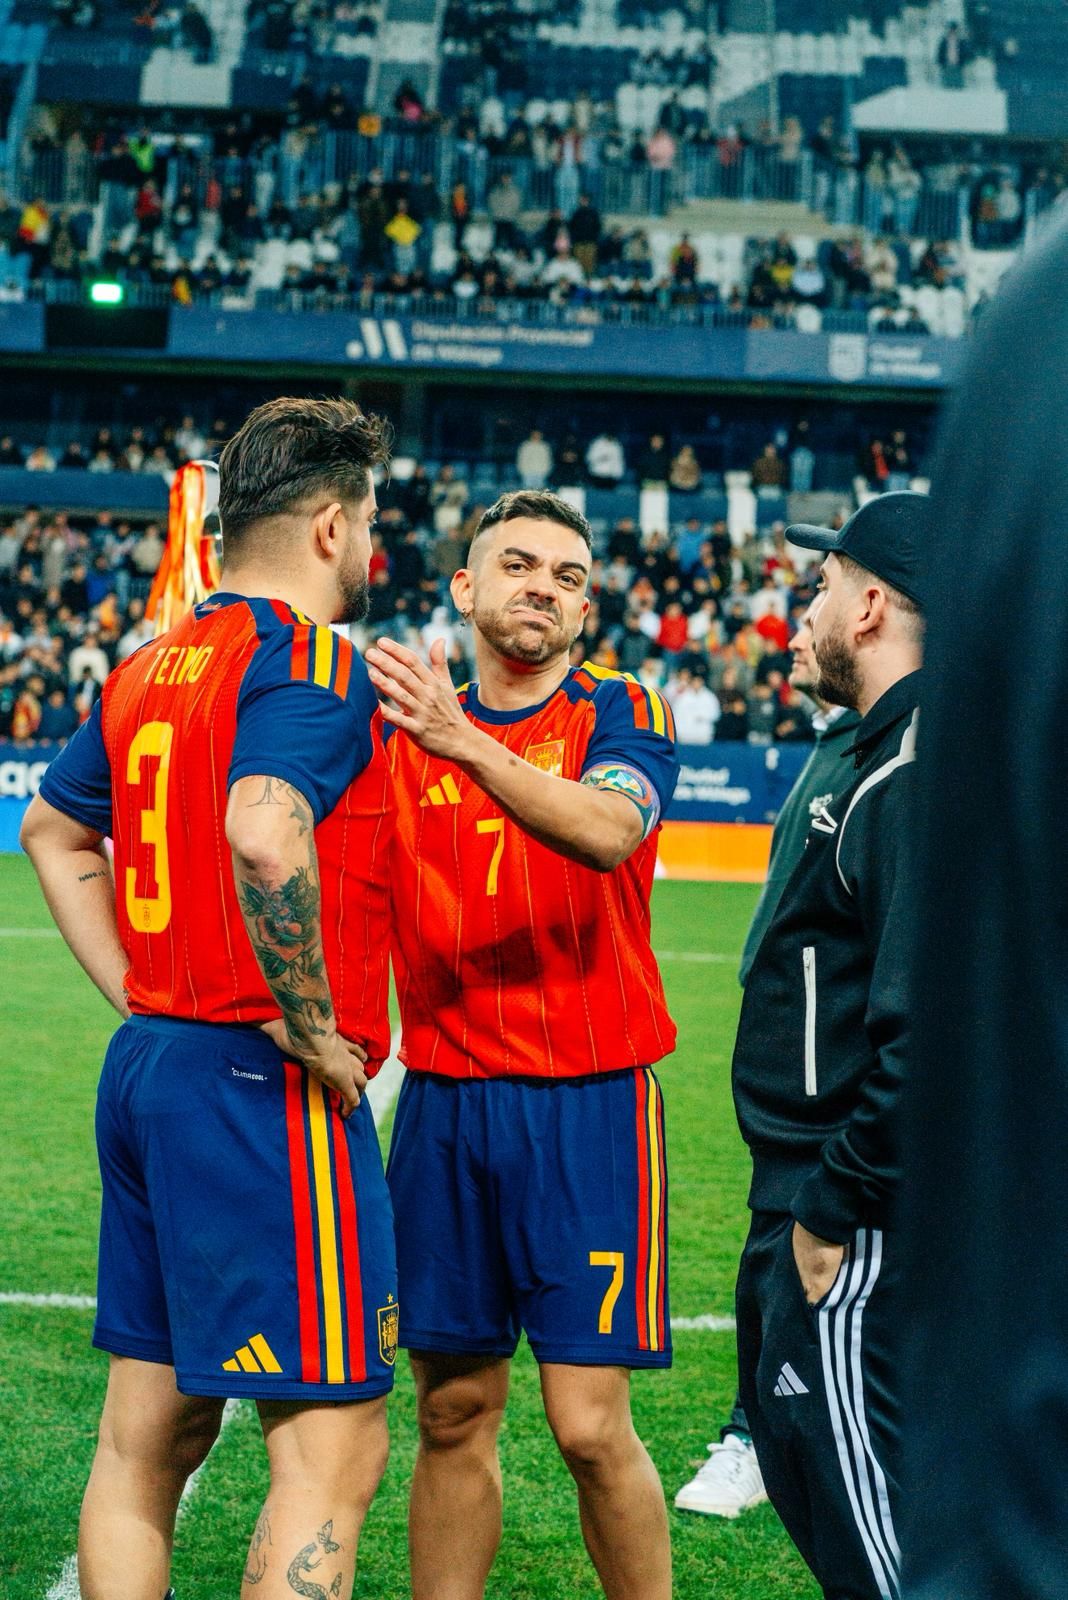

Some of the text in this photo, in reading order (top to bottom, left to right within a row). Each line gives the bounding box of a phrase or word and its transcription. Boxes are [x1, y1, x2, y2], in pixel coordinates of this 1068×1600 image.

[126, 721, 174, 933] 3
[476, 817, 504, 896] 7
[589, 1252, 624, 1334] 7
